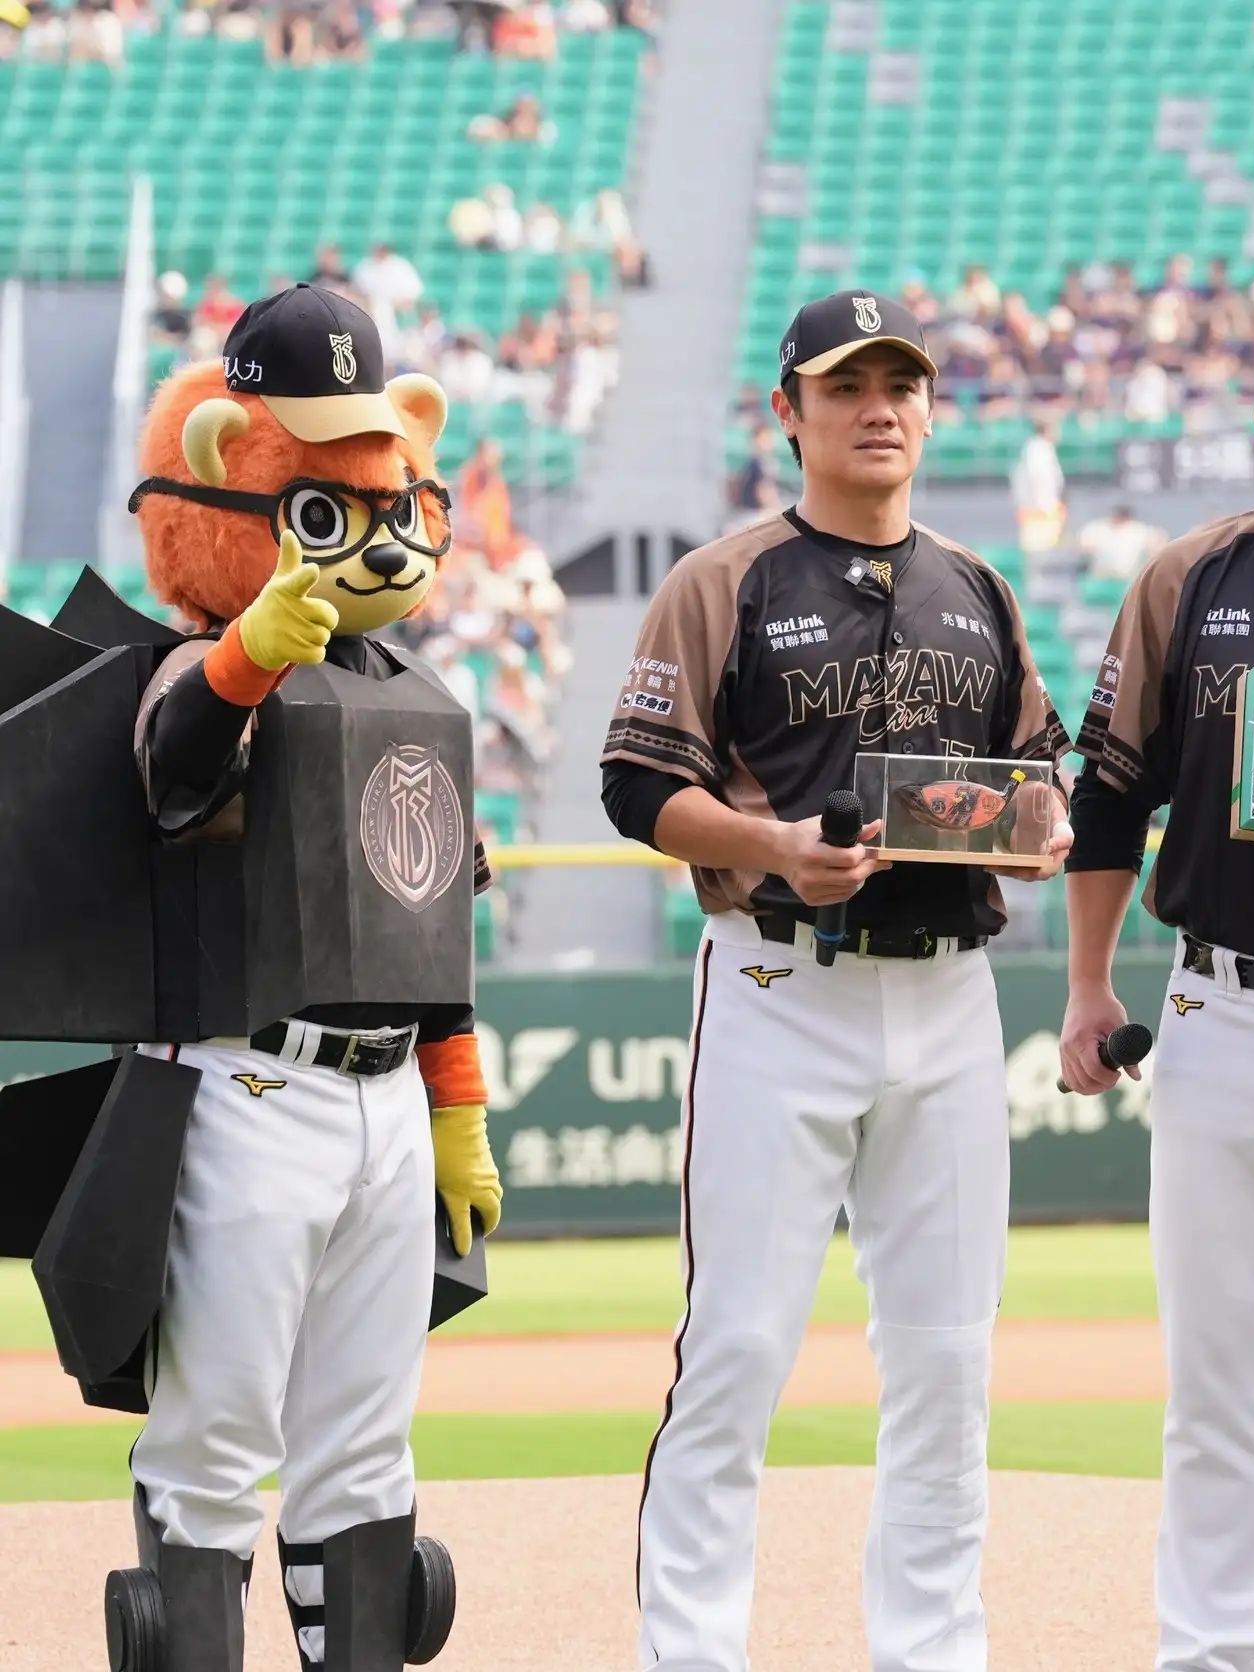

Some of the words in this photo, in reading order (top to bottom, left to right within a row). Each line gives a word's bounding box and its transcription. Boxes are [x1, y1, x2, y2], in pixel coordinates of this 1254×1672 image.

[766, 614, 825, 636] BizLink
[1206, 608, 1250, 622] izLink
[770, 628, 829, 652] 貿聯集團
[780, 648, 996, 726] MAYAW
[635, 693, 671, 713] 宅急便
